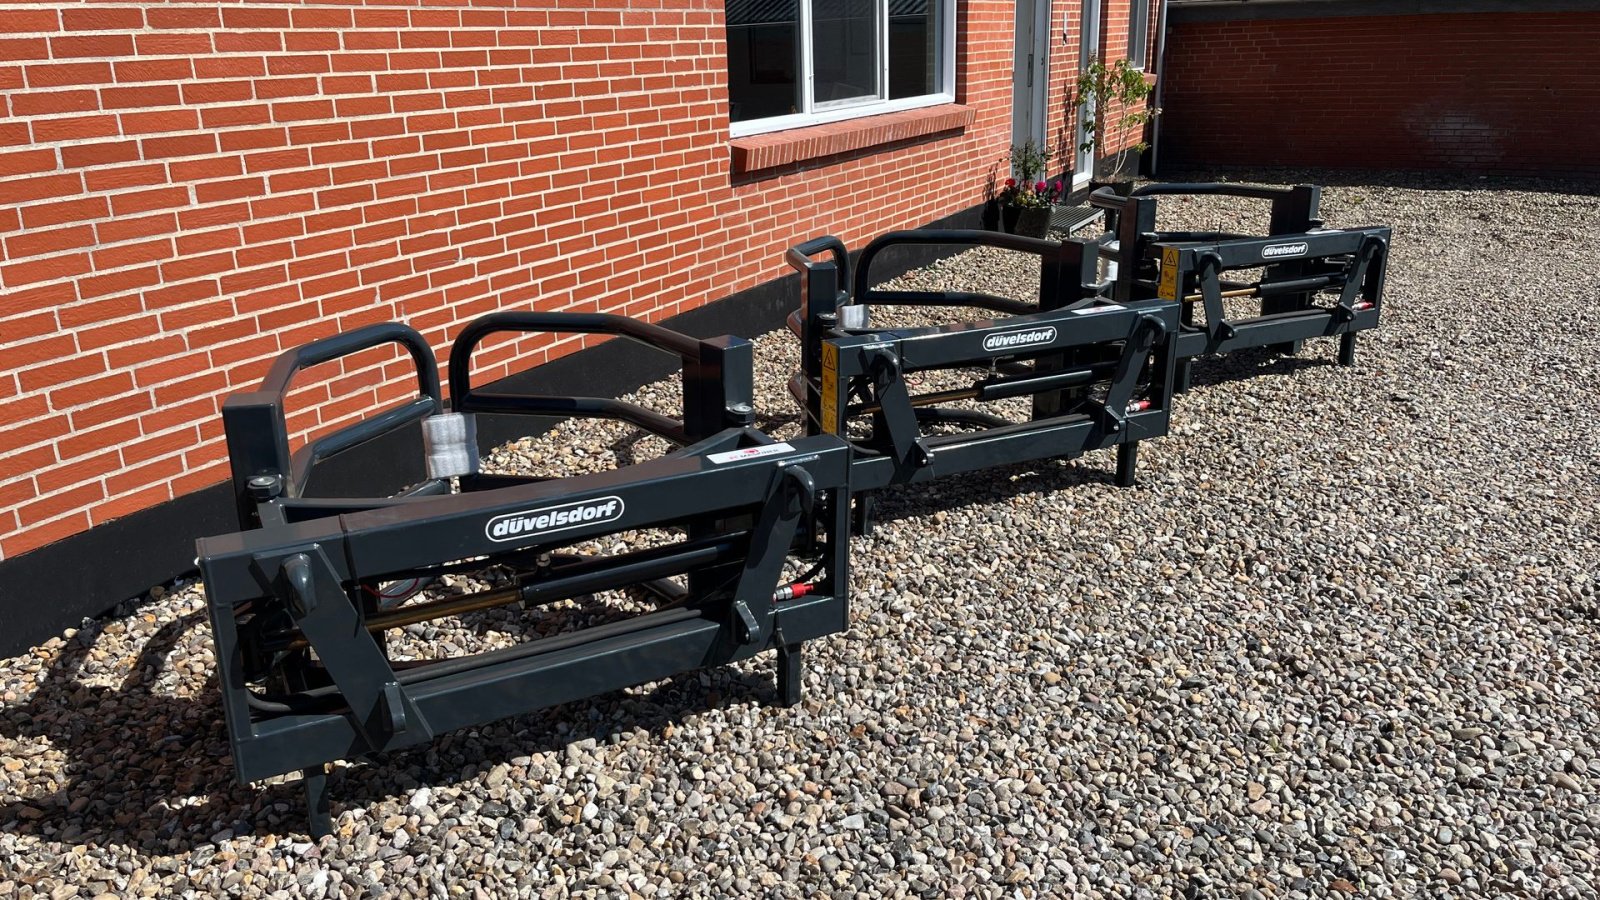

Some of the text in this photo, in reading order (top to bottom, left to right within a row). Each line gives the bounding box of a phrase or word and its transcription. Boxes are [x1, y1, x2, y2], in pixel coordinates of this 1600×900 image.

[1263, 245, 1306, 255] düvelsdorf
[986, 329, 1053, 347] düvelsdorf
[493, 501, 617, 536] düvelsdorf
